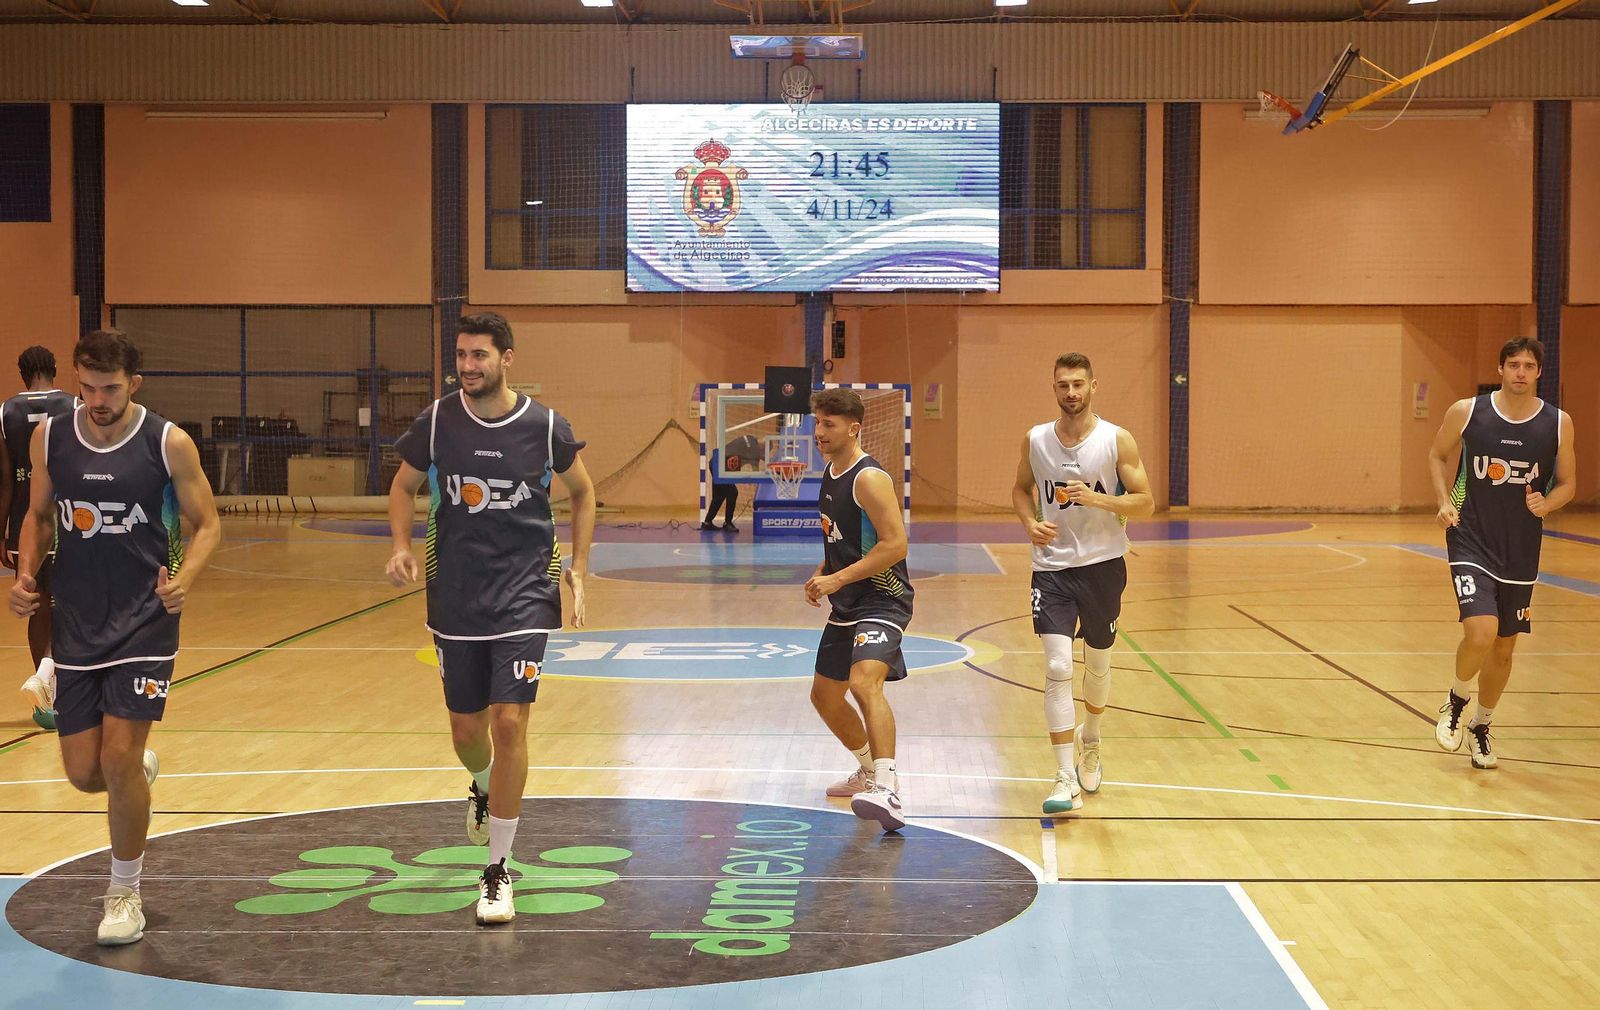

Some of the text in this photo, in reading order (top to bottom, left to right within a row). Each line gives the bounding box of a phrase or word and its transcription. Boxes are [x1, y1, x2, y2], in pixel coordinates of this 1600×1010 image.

[761, 118, 978, 131] ALGECIRAS ES DEPORTE
[809, 152, 890, 178] 21:45
[806, 197, 894, 220] 4/11/24
[674, 240, 751, 249] Ayuntamiento
[674, 250, 751, 261] de Algeciras
[1474, 455, 1539, 486] UDEA
[446, 474, 532, 513] UDEA
[1044, 480, 1108, 510] UDA
[58, 499, 149, 538] UDEA
[762, 518, 821, 529] SPORTSYSTE
[1454, 575, 1476, 597] 13
[650, 819, 812, 956] damex.io
